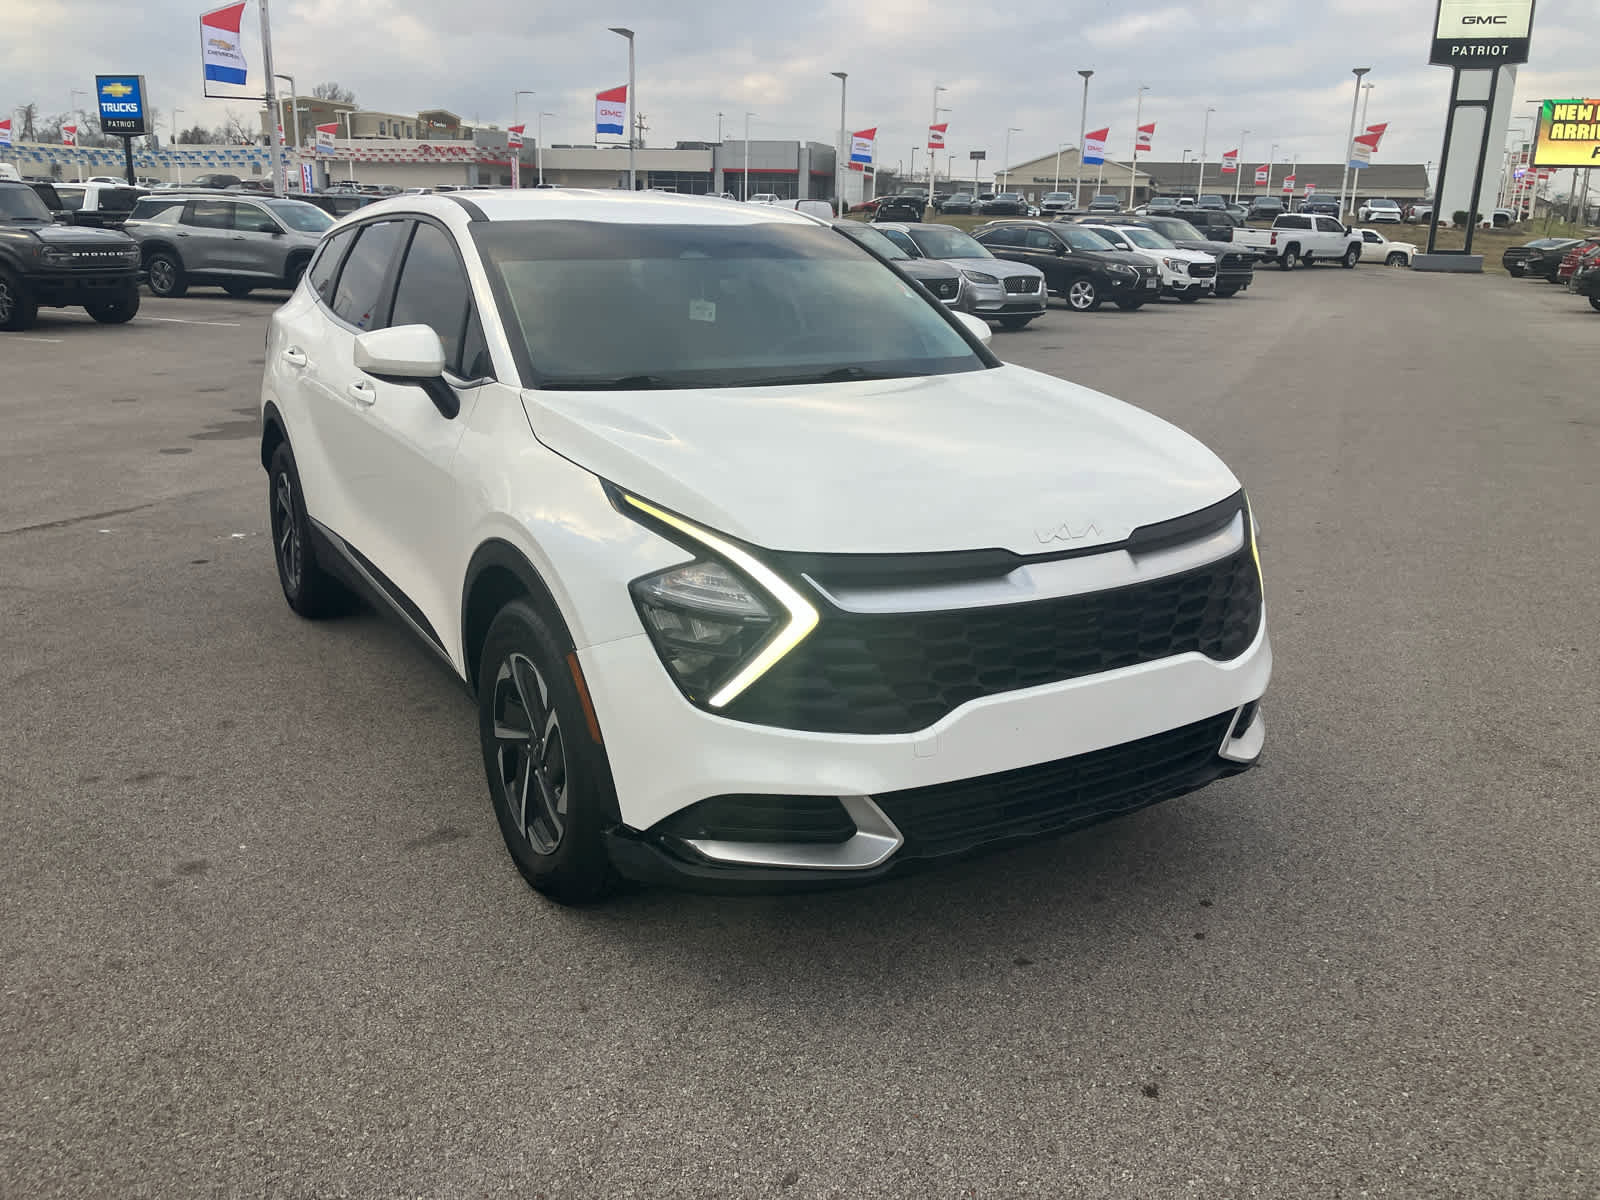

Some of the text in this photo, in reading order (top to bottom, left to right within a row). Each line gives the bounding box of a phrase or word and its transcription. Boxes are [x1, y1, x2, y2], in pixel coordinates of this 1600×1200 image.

[1461, 15, 1508, 25] GMC
[1451, 45, 1509, 56] PATRIOT
[101, 102, 138, 112] TRUCKS
[600, 109, 623, 117] GMC
[1553, 104, 1594, 121] NEW
[107, 120, 135, 128] PATRIOT
[1032, 522, 1104, 544] KIA
